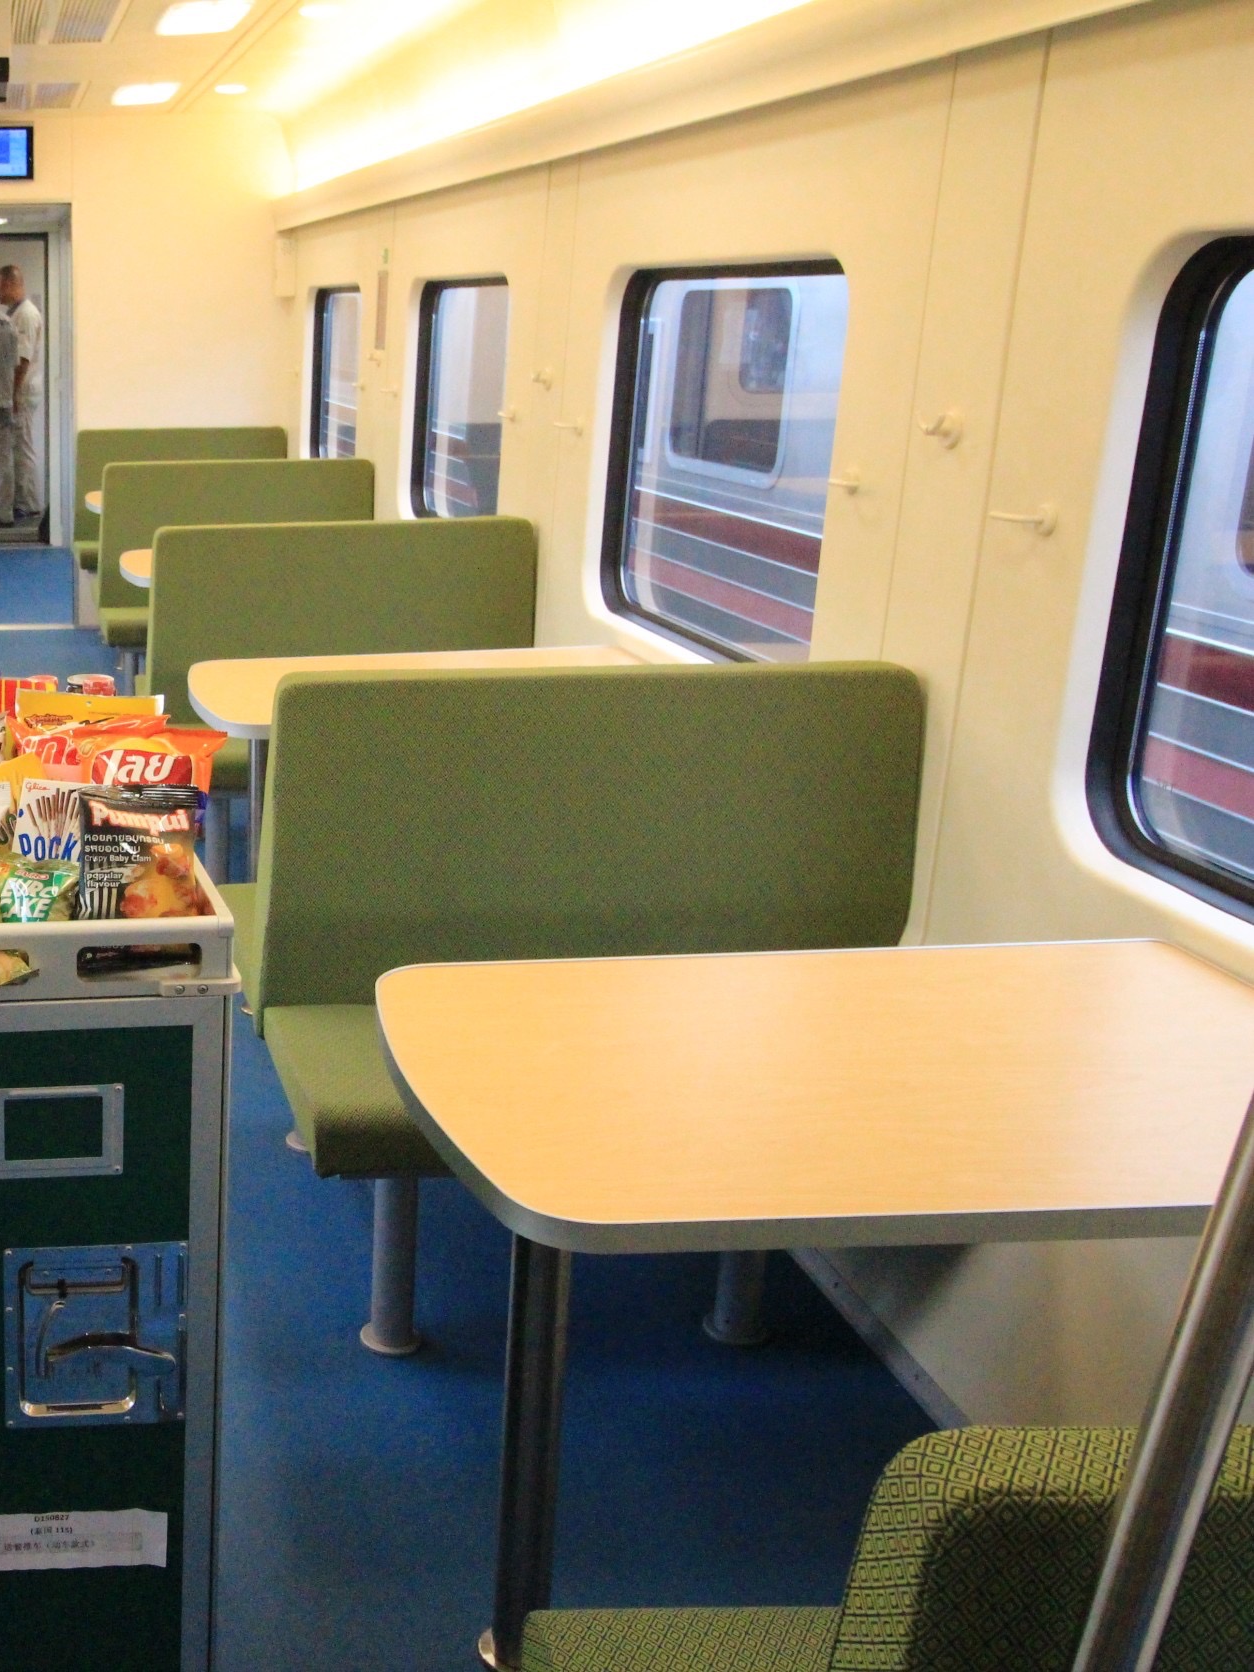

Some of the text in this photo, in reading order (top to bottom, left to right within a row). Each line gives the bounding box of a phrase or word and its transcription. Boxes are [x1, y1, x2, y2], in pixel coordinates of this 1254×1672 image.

[89, 800, 189, 836] Pumpui
[18, 832, 82, 862] POCK
[84, 854, 151, 863] Crispy Baby Clam
[86, 871, 123, 881] popular
[86, 880, 121, 889] flavour
[1, 877, 59, 898] EURO
[0, 897, 52, 919] CAKE
